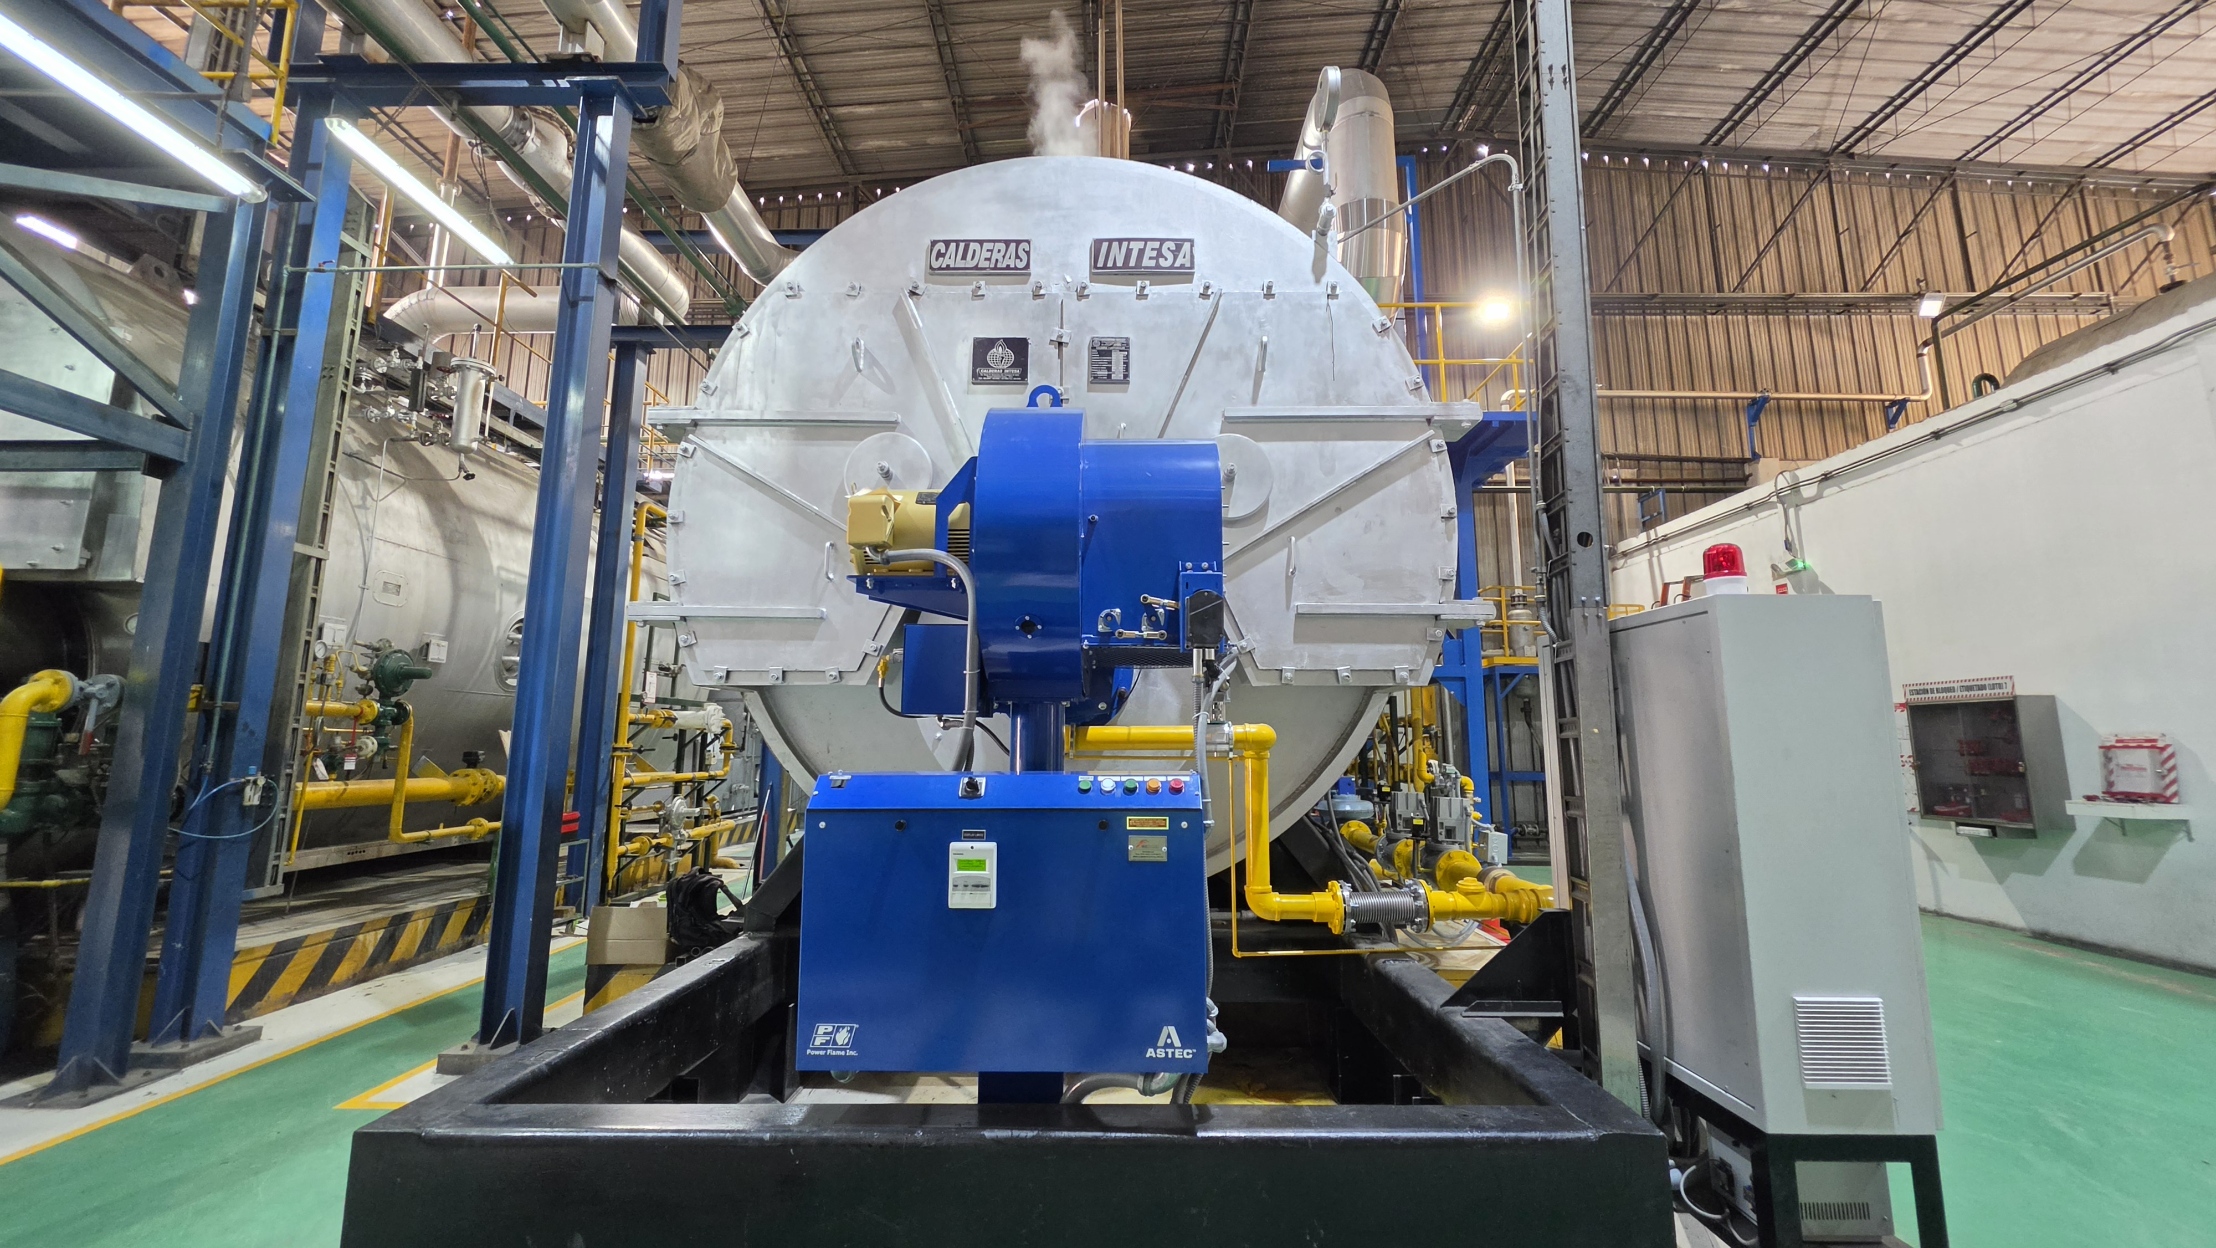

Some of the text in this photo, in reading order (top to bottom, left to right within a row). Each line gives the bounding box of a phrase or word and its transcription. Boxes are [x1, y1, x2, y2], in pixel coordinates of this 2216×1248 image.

[931, 242, 1030, 269] CALDERAS
[1096, 241, 1191, 268] INTESA
[1909, 687, 1929, 696] ESTACIÓN
[1930, 687, 1936, 695] DE
[1959, 684, 1987, 693] ETIQUETADO
